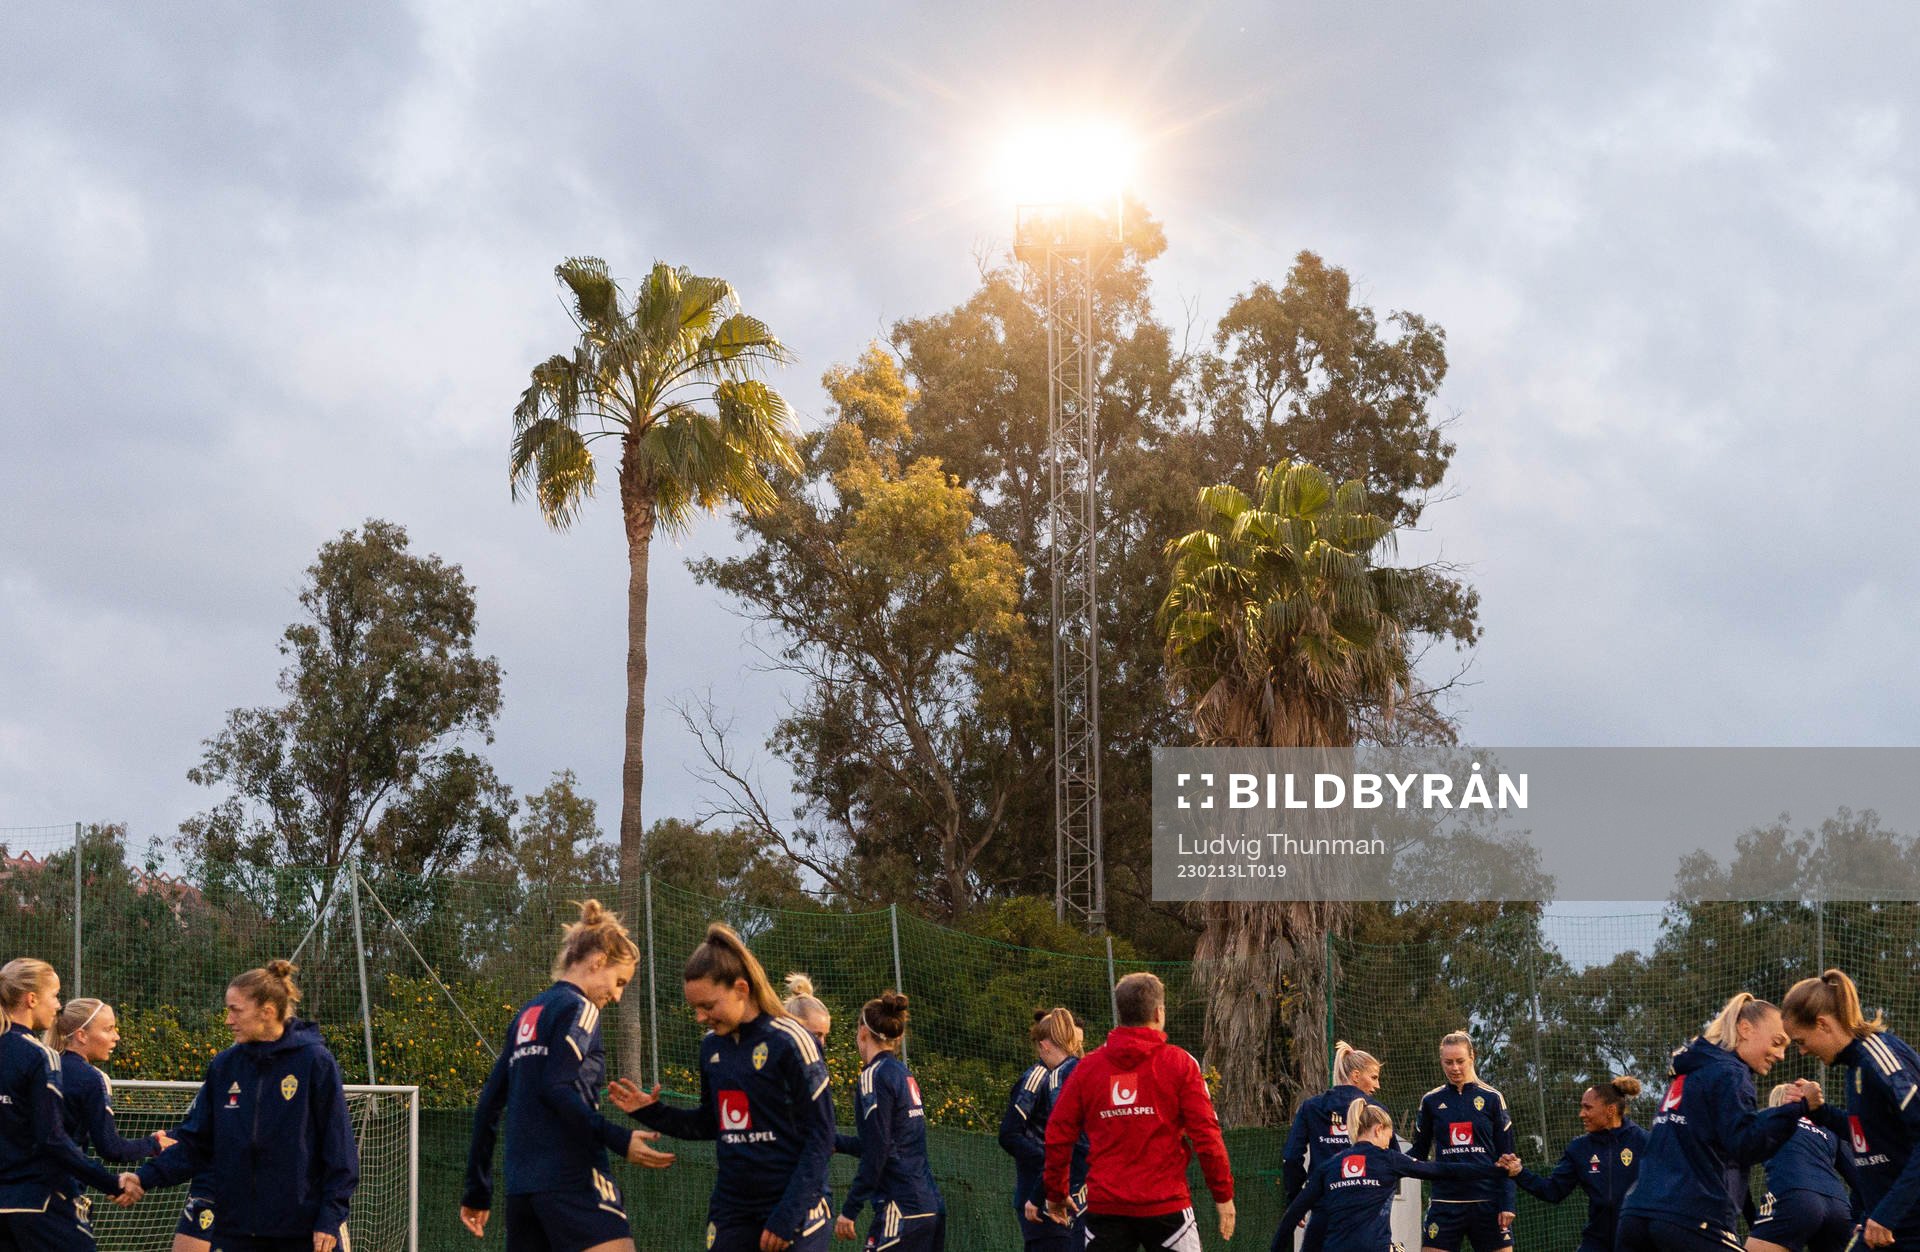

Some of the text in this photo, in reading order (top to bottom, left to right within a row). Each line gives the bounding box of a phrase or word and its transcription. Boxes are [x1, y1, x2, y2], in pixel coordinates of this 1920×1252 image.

[1133, 1106, 1155, 1115] SPEL
[749, 1131, 776, 1143] SPEL
[1329, 1179, 1361, 1190] SVENSKA
